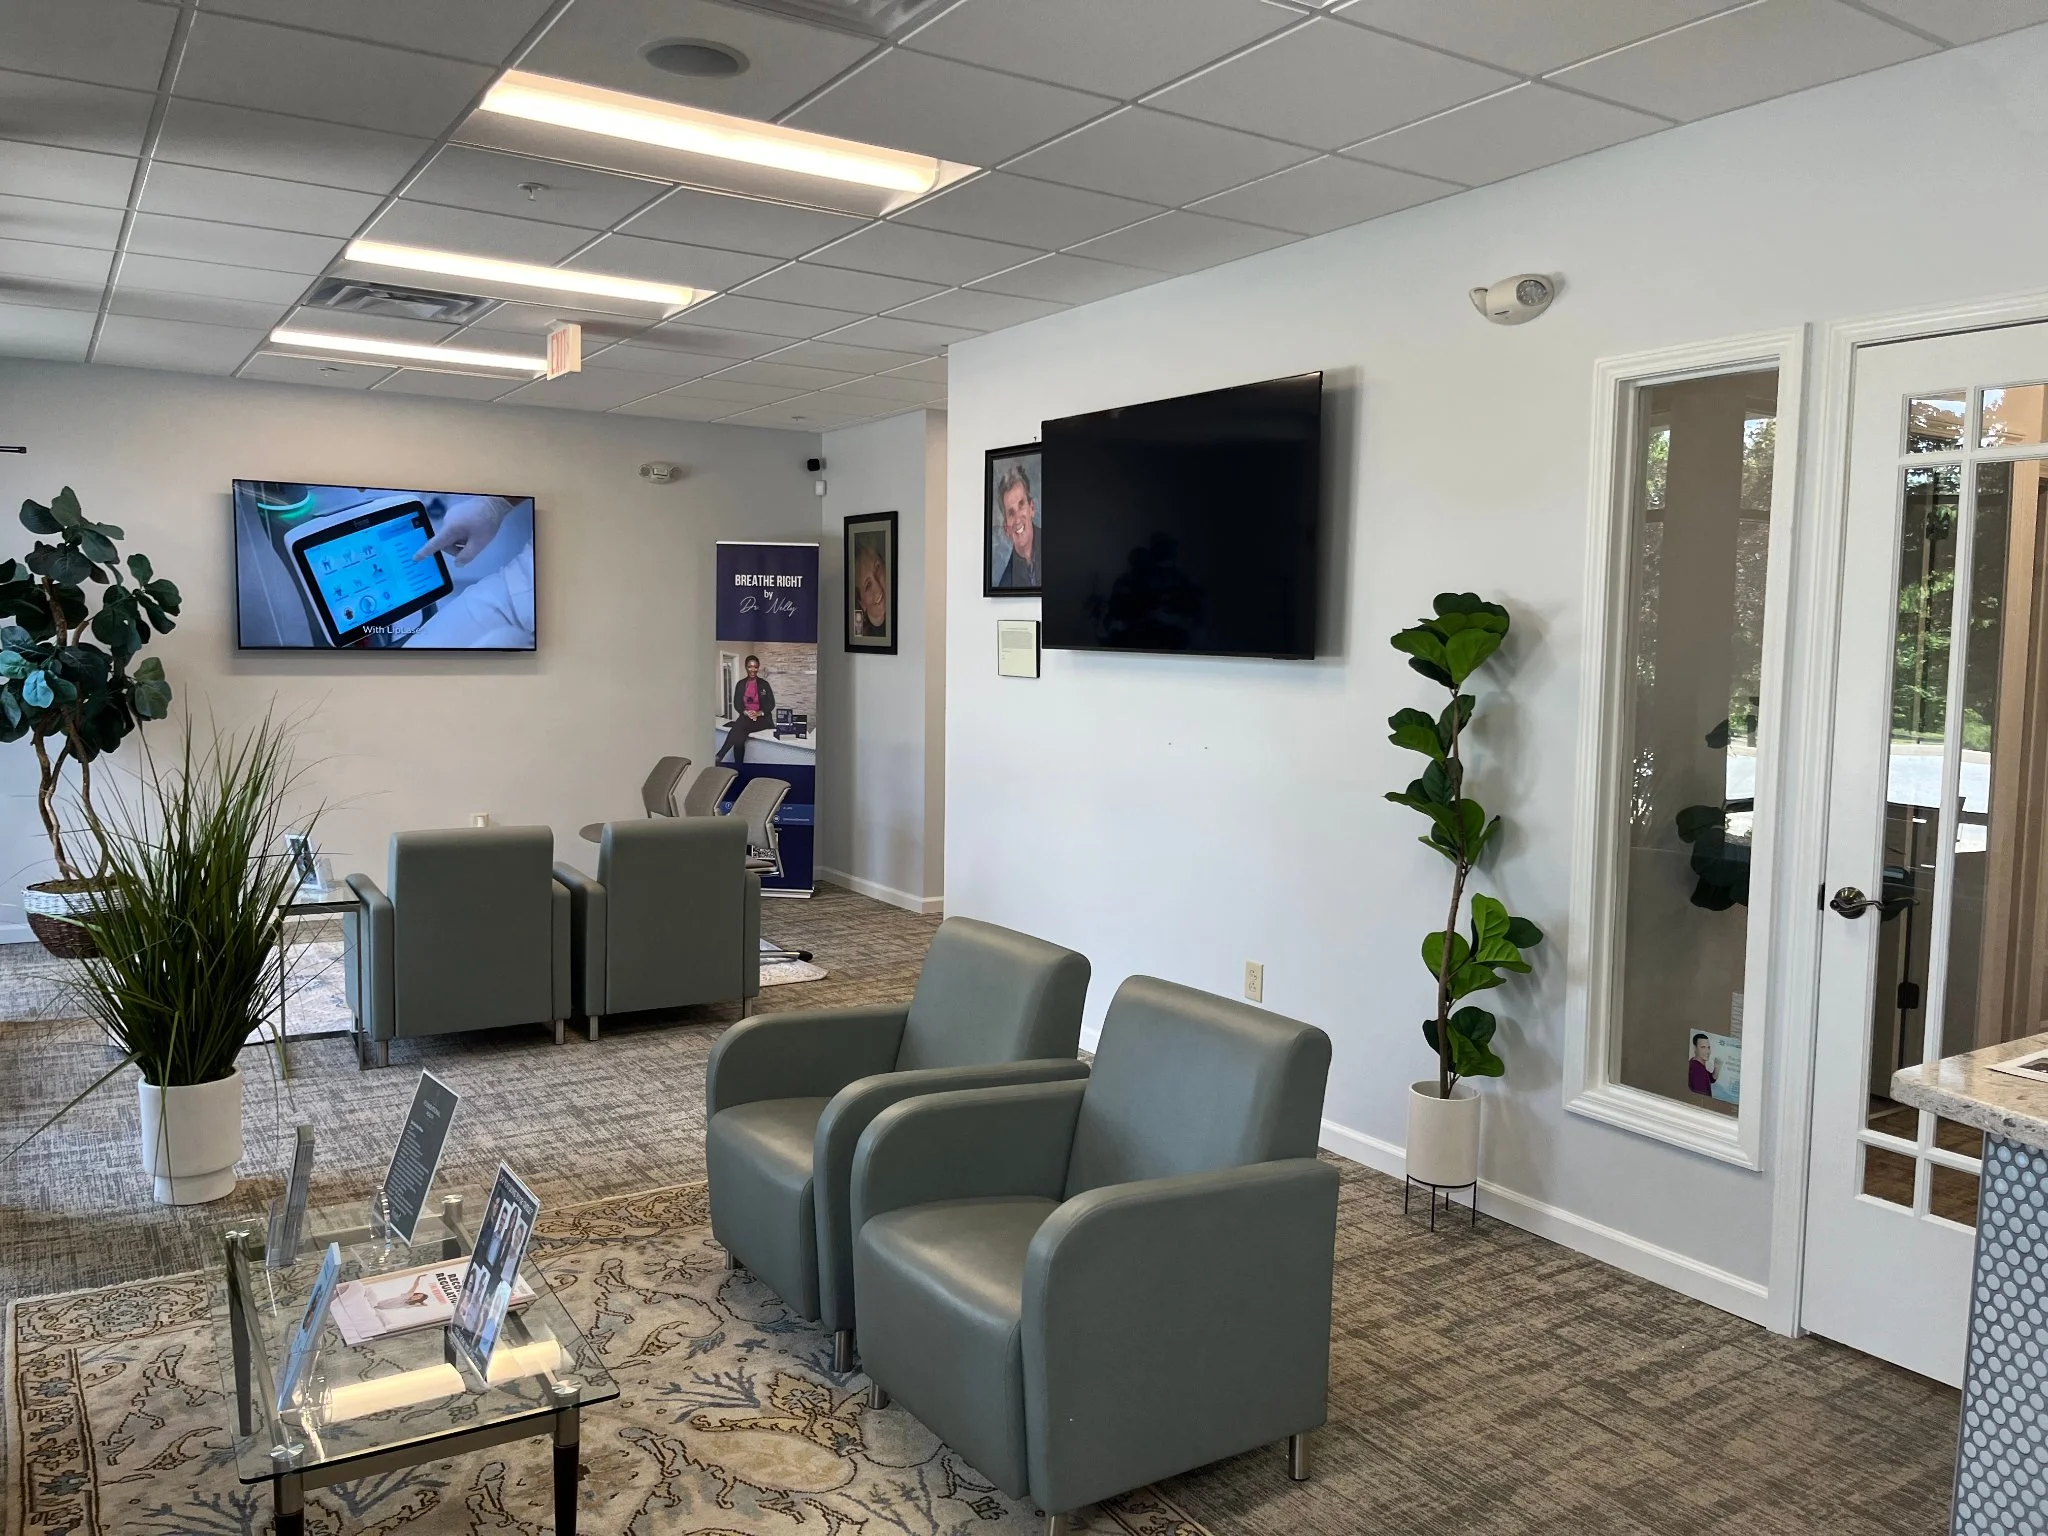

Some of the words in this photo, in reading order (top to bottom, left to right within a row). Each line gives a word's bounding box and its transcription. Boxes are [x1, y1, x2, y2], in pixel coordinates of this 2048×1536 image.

[735, 574, 774, 586] BREATHE
[777, 575, 803, 587] RIGHT
[764, 589, 773, 600] by
[362, 625, 385, 634] With
